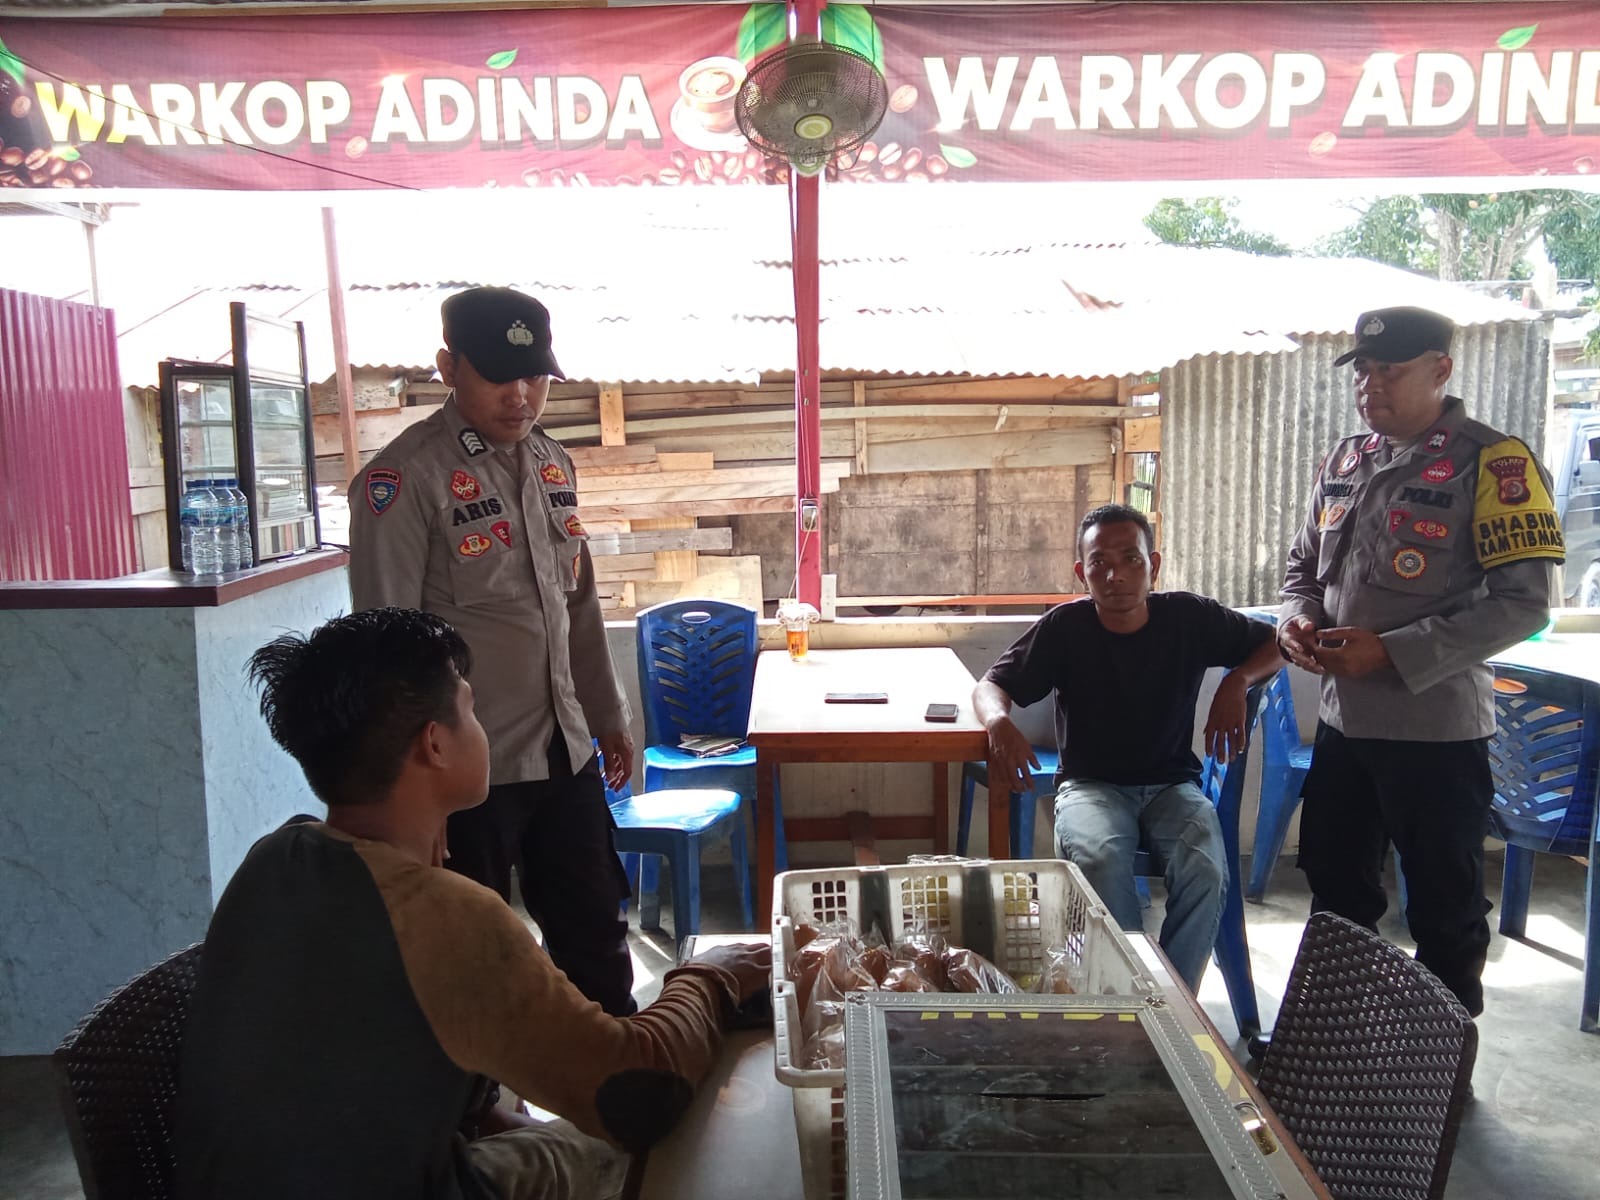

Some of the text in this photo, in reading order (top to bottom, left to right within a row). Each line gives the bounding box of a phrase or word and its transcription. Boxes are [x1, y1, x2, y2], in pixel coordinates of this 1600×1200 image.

[923, 51, 1326, 131] WARKOP
[34, 74, 661, 145] WARKOP ADINDA
[452, 497, 502, 527] ARIS
[1399, 487, 1453, 508] POLRI
[1479, 512, 1556, 540] BHABIN
[1479, 530, 1564, 557] KAMTIBMAS
